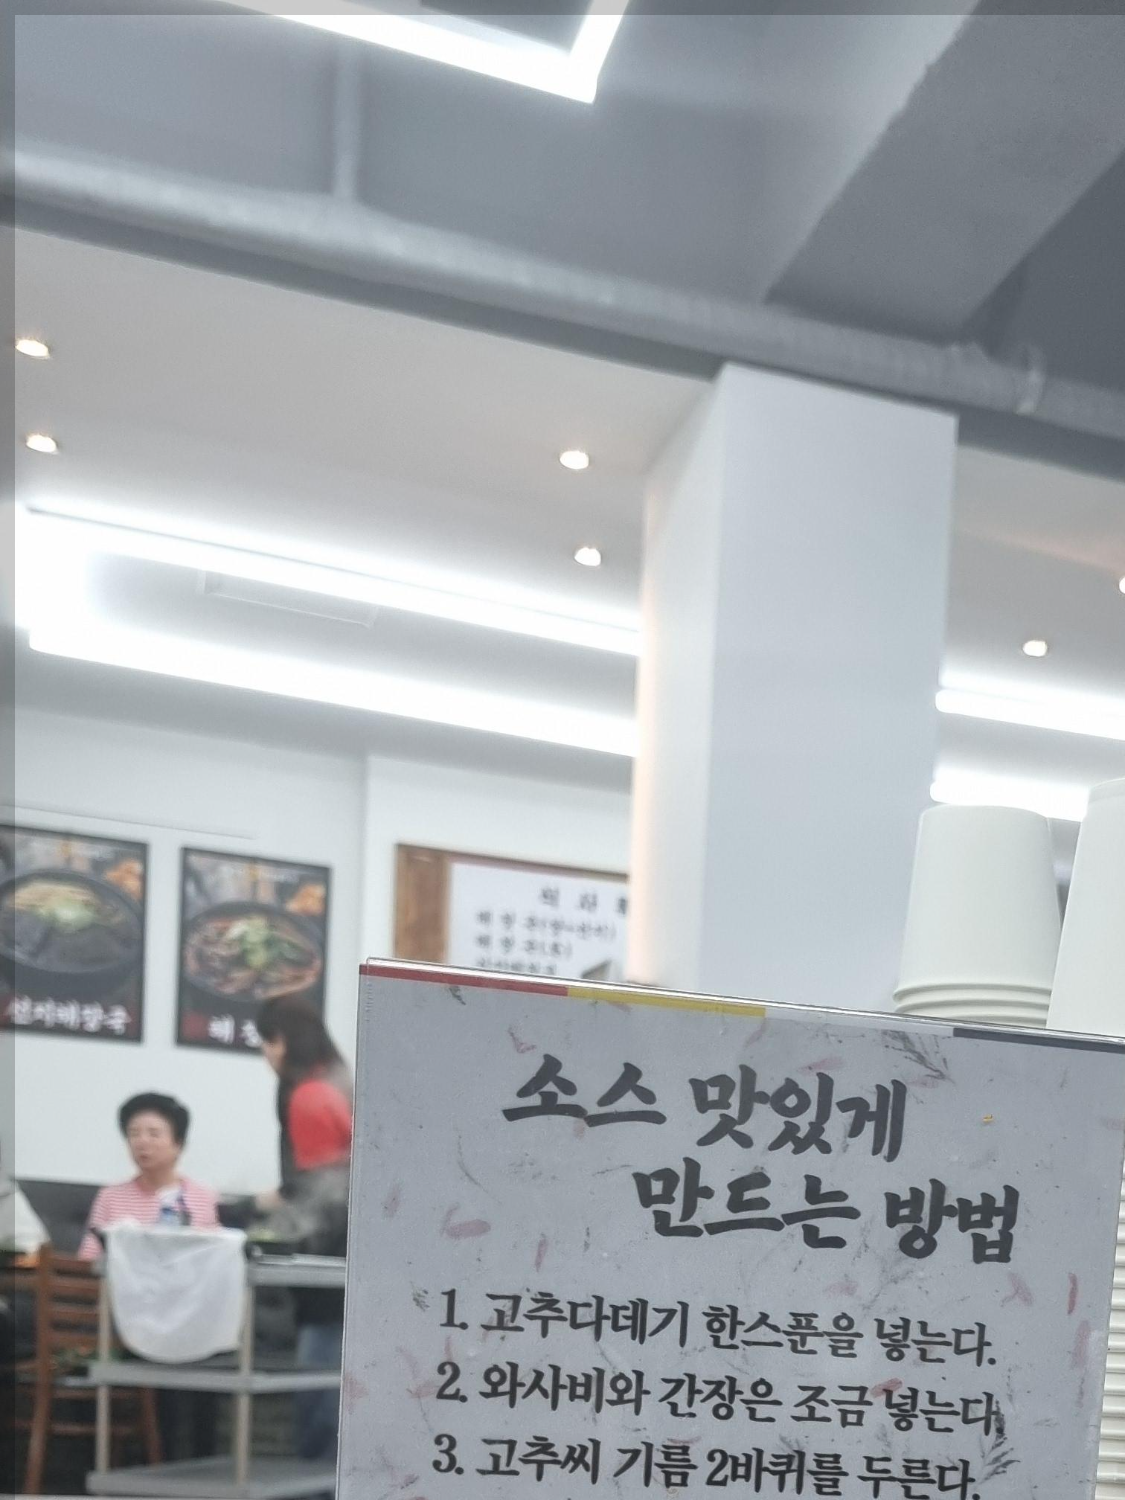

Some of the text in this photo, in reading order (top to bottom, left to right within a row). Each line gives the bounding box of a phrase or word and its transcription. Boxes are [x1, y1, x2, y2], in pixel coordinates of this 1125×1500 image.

[502, 1054, 907, 1162] 소스 맛있게
[632, 1157, 1019, 1264] 만드는 방법
[440, 1289, 996, 1367] 1. 고추다데기 한스푼을 넣는다.
[436, 1361, 467, 1402] 2.
[479, 1362, 651, 1416] 와사비와
[659, 1373, 783, 1422] 간장은
[791, 1386, 873, 1428] 조금
[433, 1434, 464, 1475] 3.
[476, 1436, 600, 1484] 고추씨
[613, 1441, 698, 1488] 기름
[706, 1448, 849, 1496] 2바퀴를
